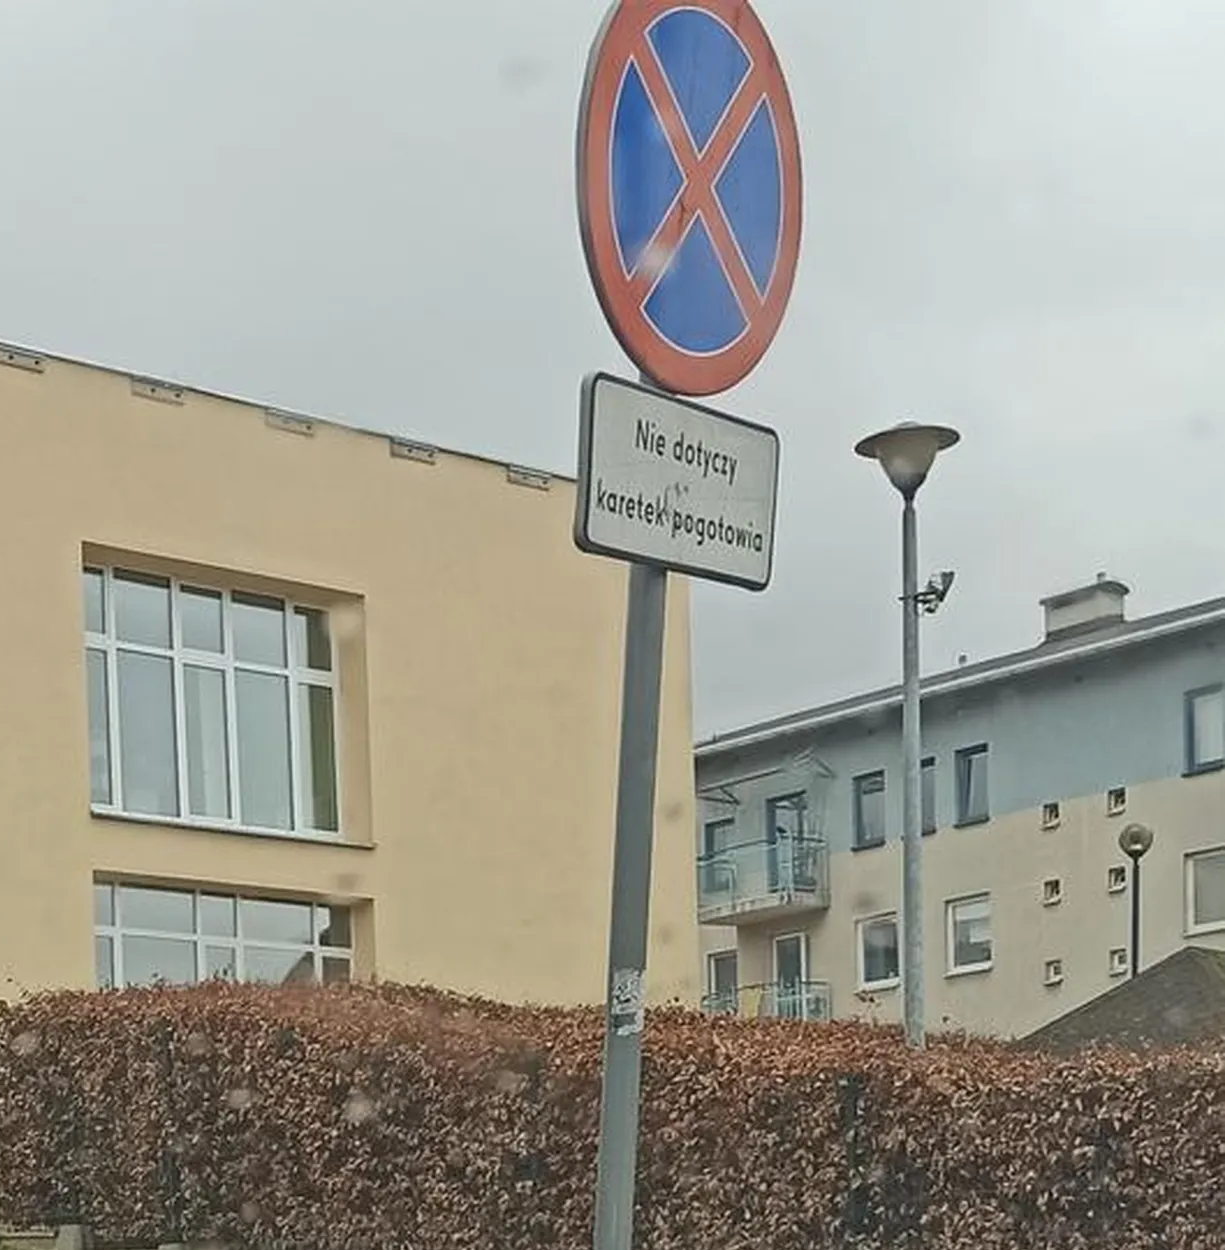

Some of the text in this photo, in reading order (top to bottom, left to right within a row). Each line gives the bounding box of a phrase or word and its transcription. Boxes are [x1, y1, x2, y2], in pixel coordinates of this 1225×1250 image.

[636, 419, 738, 485] Nie dotyczy
[597, 478, 764, 552] karetek pogotowia
